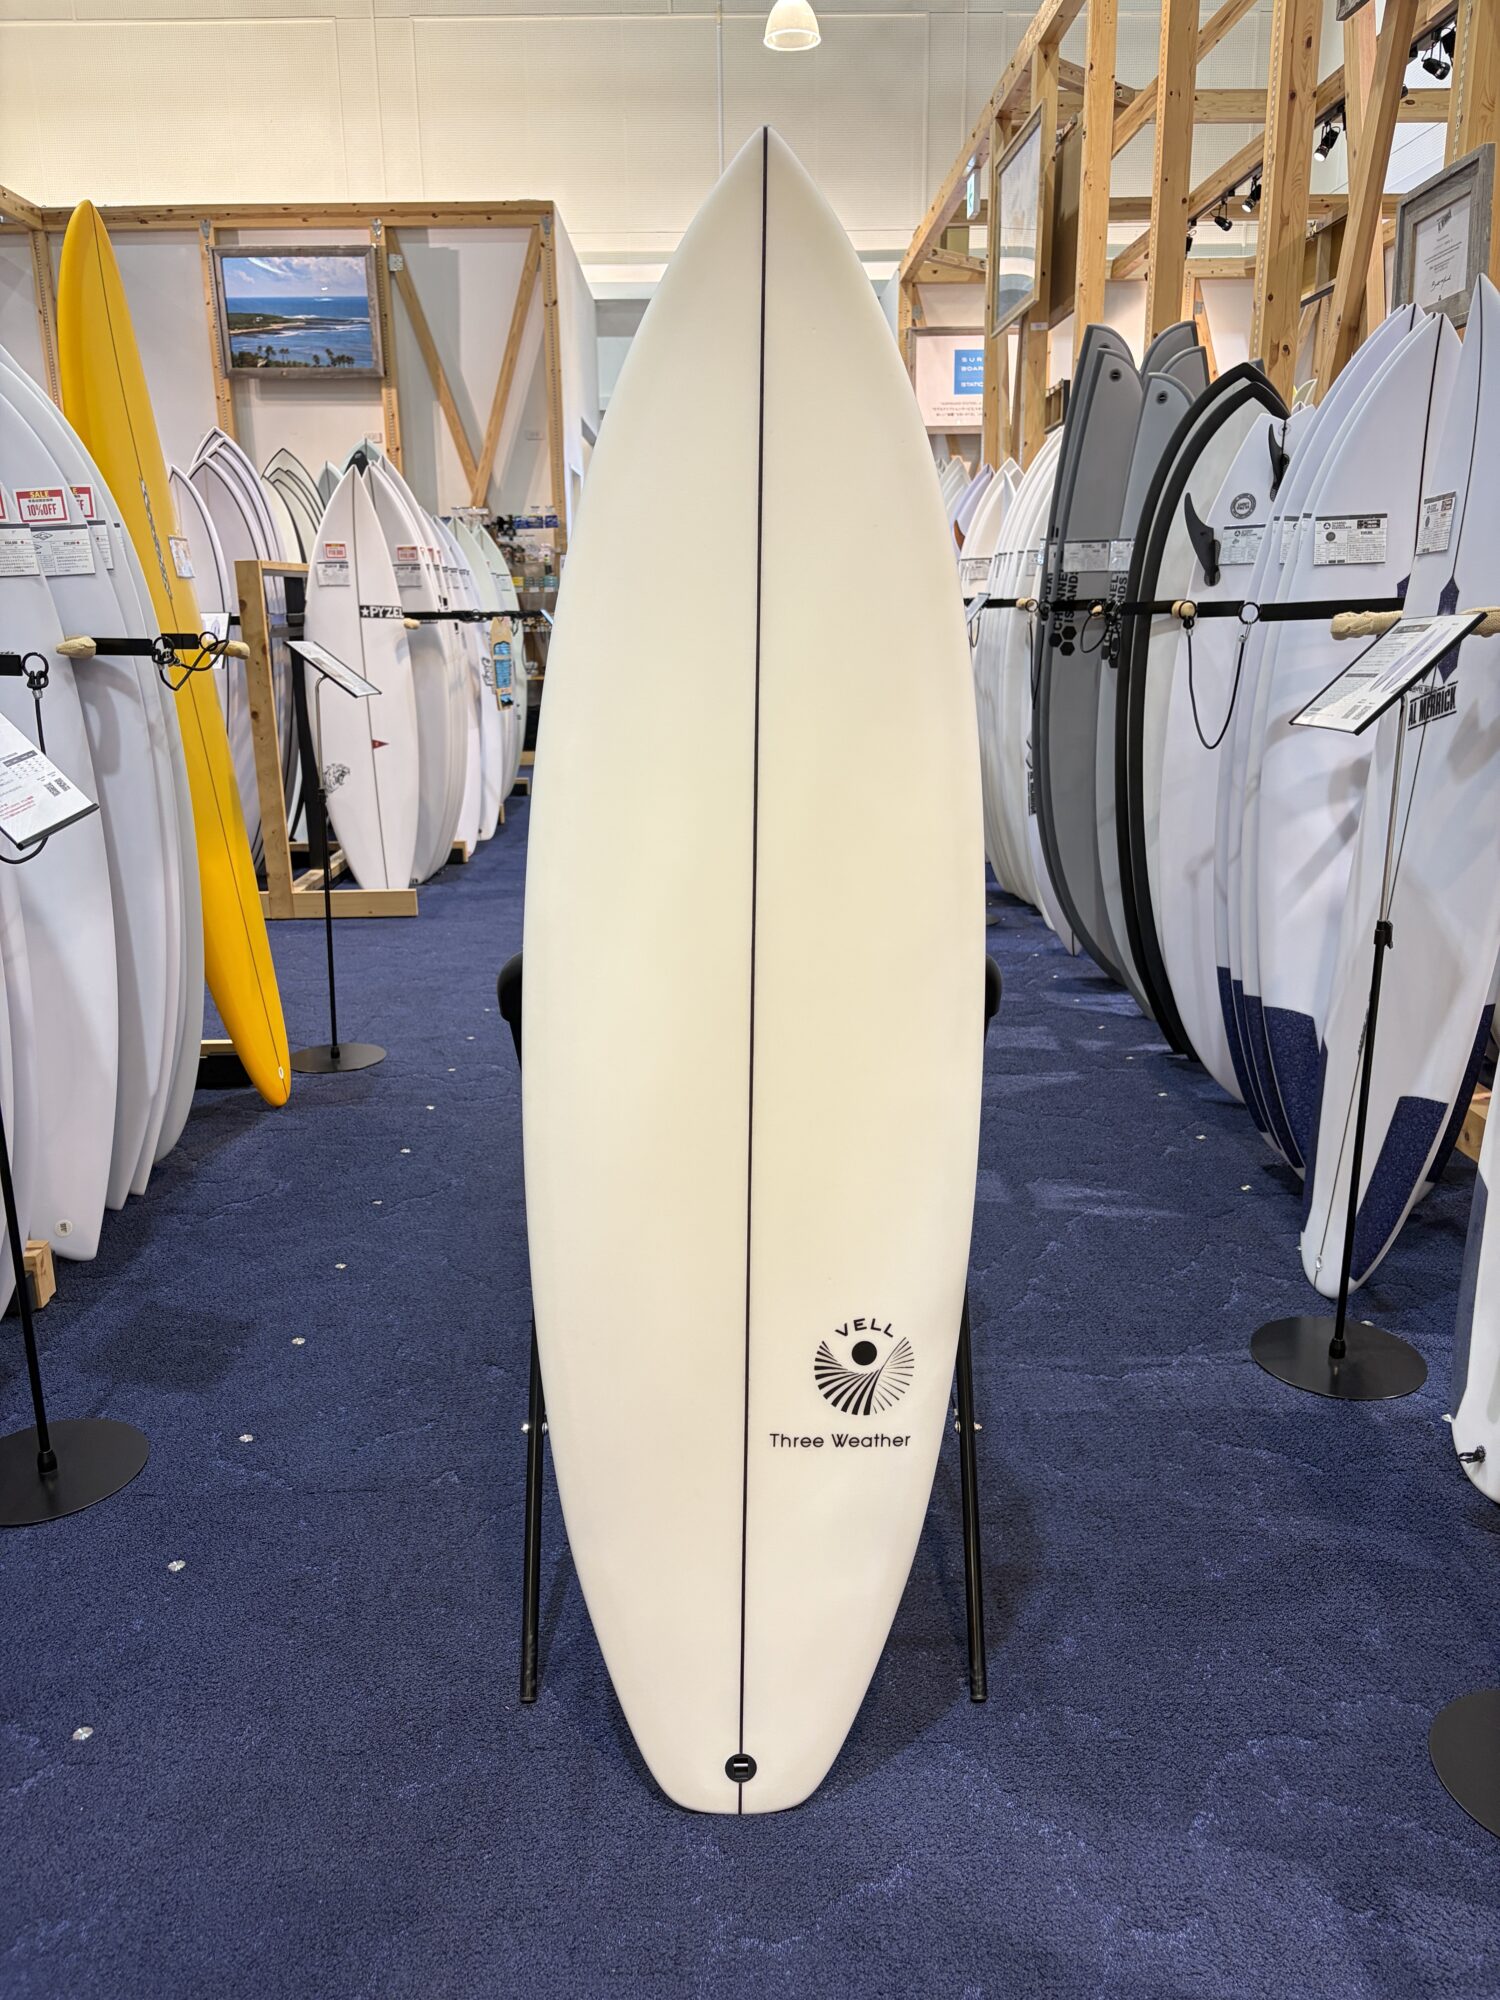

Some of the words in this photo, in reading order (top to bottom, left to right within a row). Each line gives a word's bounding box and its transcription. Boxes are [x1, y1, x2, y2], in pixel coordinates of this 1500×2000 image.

[29, 490, 49, 498] SALE
[26, 503, 57, 517] 10%OFF
[370, 606, 404, 619] PYZEL
[1408, 701, 1417, 727] AL
[1418, 685, 1457, 722] MERRICK
[835, 1318, 894, 1338] VELL
[769, 1433, 825, 1448] Three
[831, 1433, 911, 1448] Weather
